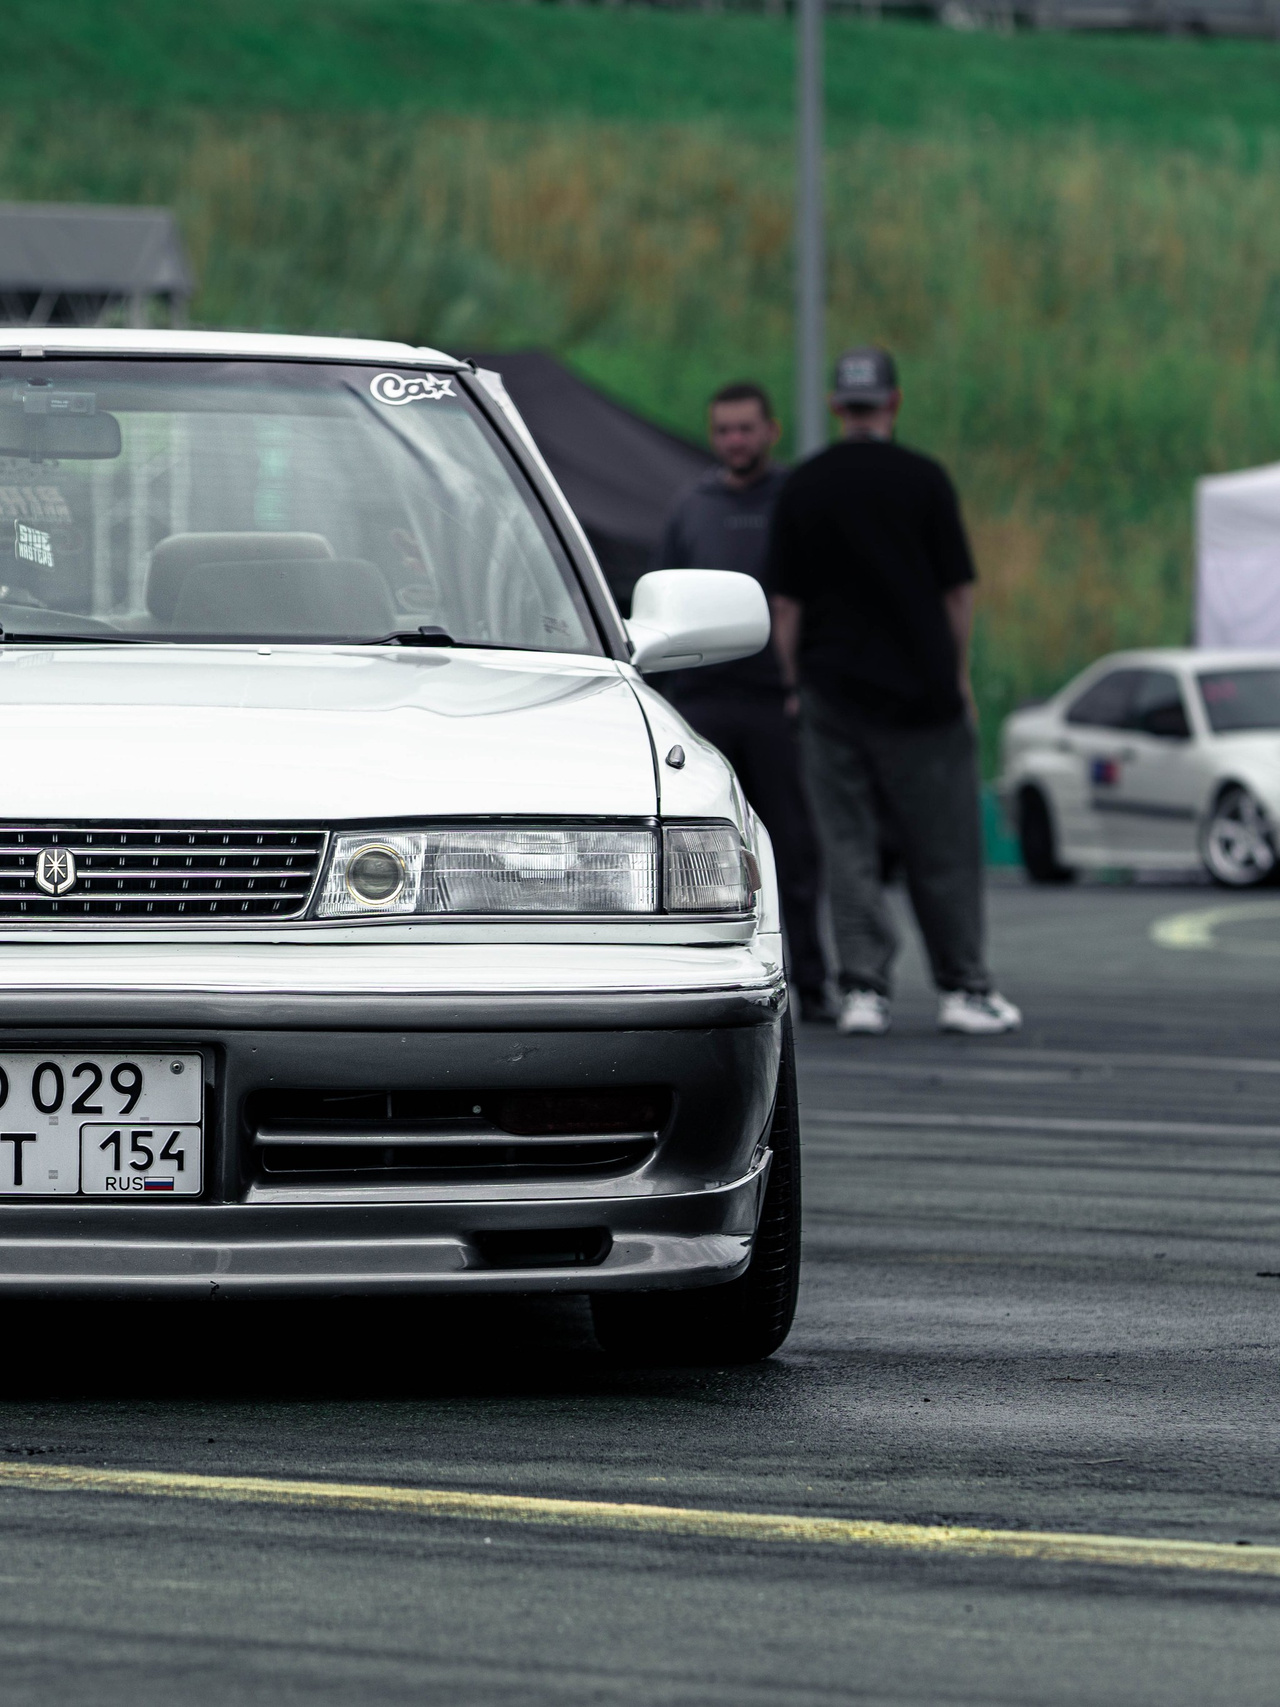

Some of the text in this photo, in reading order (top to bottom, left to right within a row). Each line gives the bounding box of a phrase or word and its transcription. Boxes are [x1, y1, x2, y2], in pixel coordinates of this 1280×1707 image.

[18, 543, 55, 568] MASTERS
[30, 1061, 143, 1114] 029
[98, 1130, 185, 1171] 154
[105, 1176, 144, 1191] RUS
